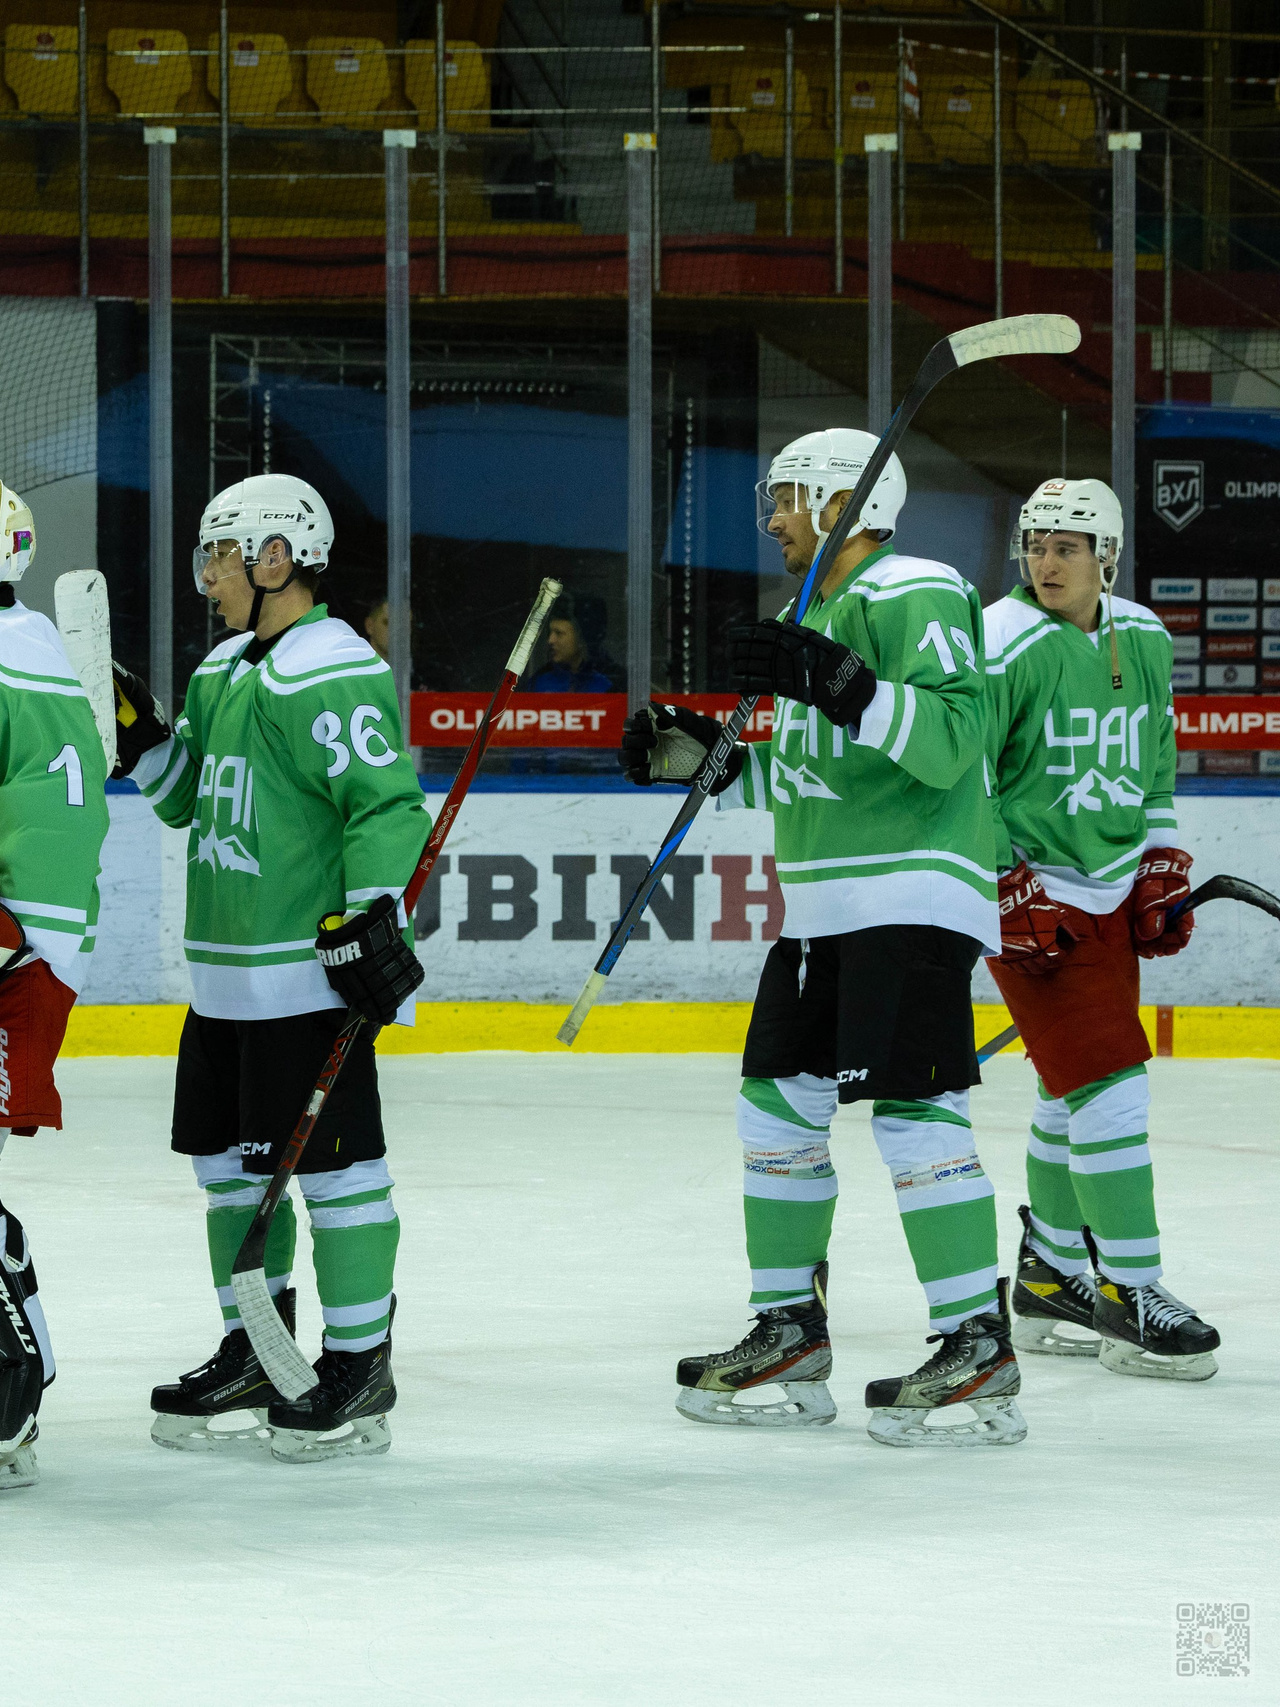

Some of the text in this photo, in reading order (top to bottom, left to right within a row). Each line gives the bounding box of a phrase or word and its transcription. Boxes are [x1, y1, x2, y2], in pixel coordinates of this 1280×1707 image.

[831, 460, 865, 470] BAUER
[1158, 478, 1200, 508] ВХЛ
[1225, 481, 1280, 498] OLIMP
[263, 512, 295, 521] CCM
[47, 743, 85, 807] 1
[429, 803, 459, 847] VAPOR
[837, 1068, 870, 1083] CM
[239, 1143, 271, 1155] CM
[213, 1379, 246, 1402] BAUER
[344, 1389, 370, 1415] BAUER
